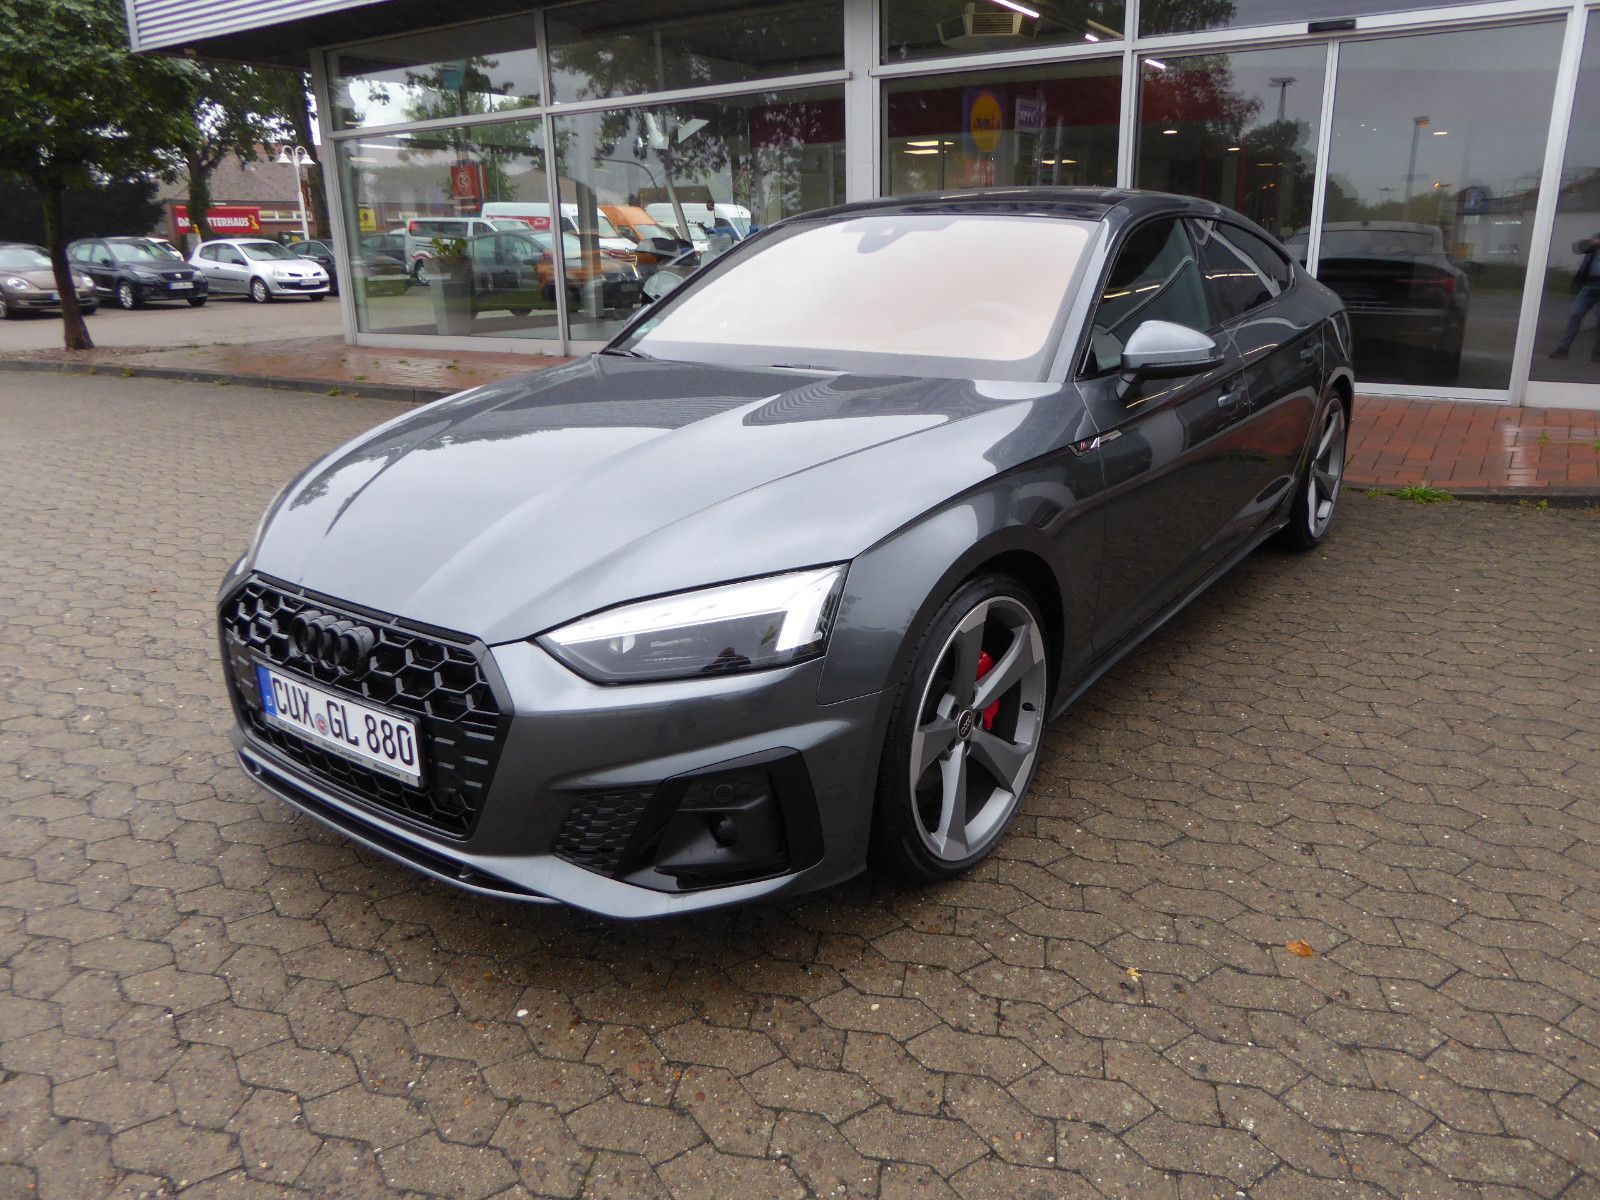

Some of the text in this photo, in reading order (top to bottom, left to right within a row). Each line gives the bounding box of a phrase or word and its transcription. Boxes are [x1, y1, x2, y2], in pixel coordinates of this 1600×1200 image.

[177, 217, 249, 227] DA TTERHAUS
[272, 677, 315, 728] CUX
[326, 700, 360, 747] GL
[365, 713, 415, 767] 880
